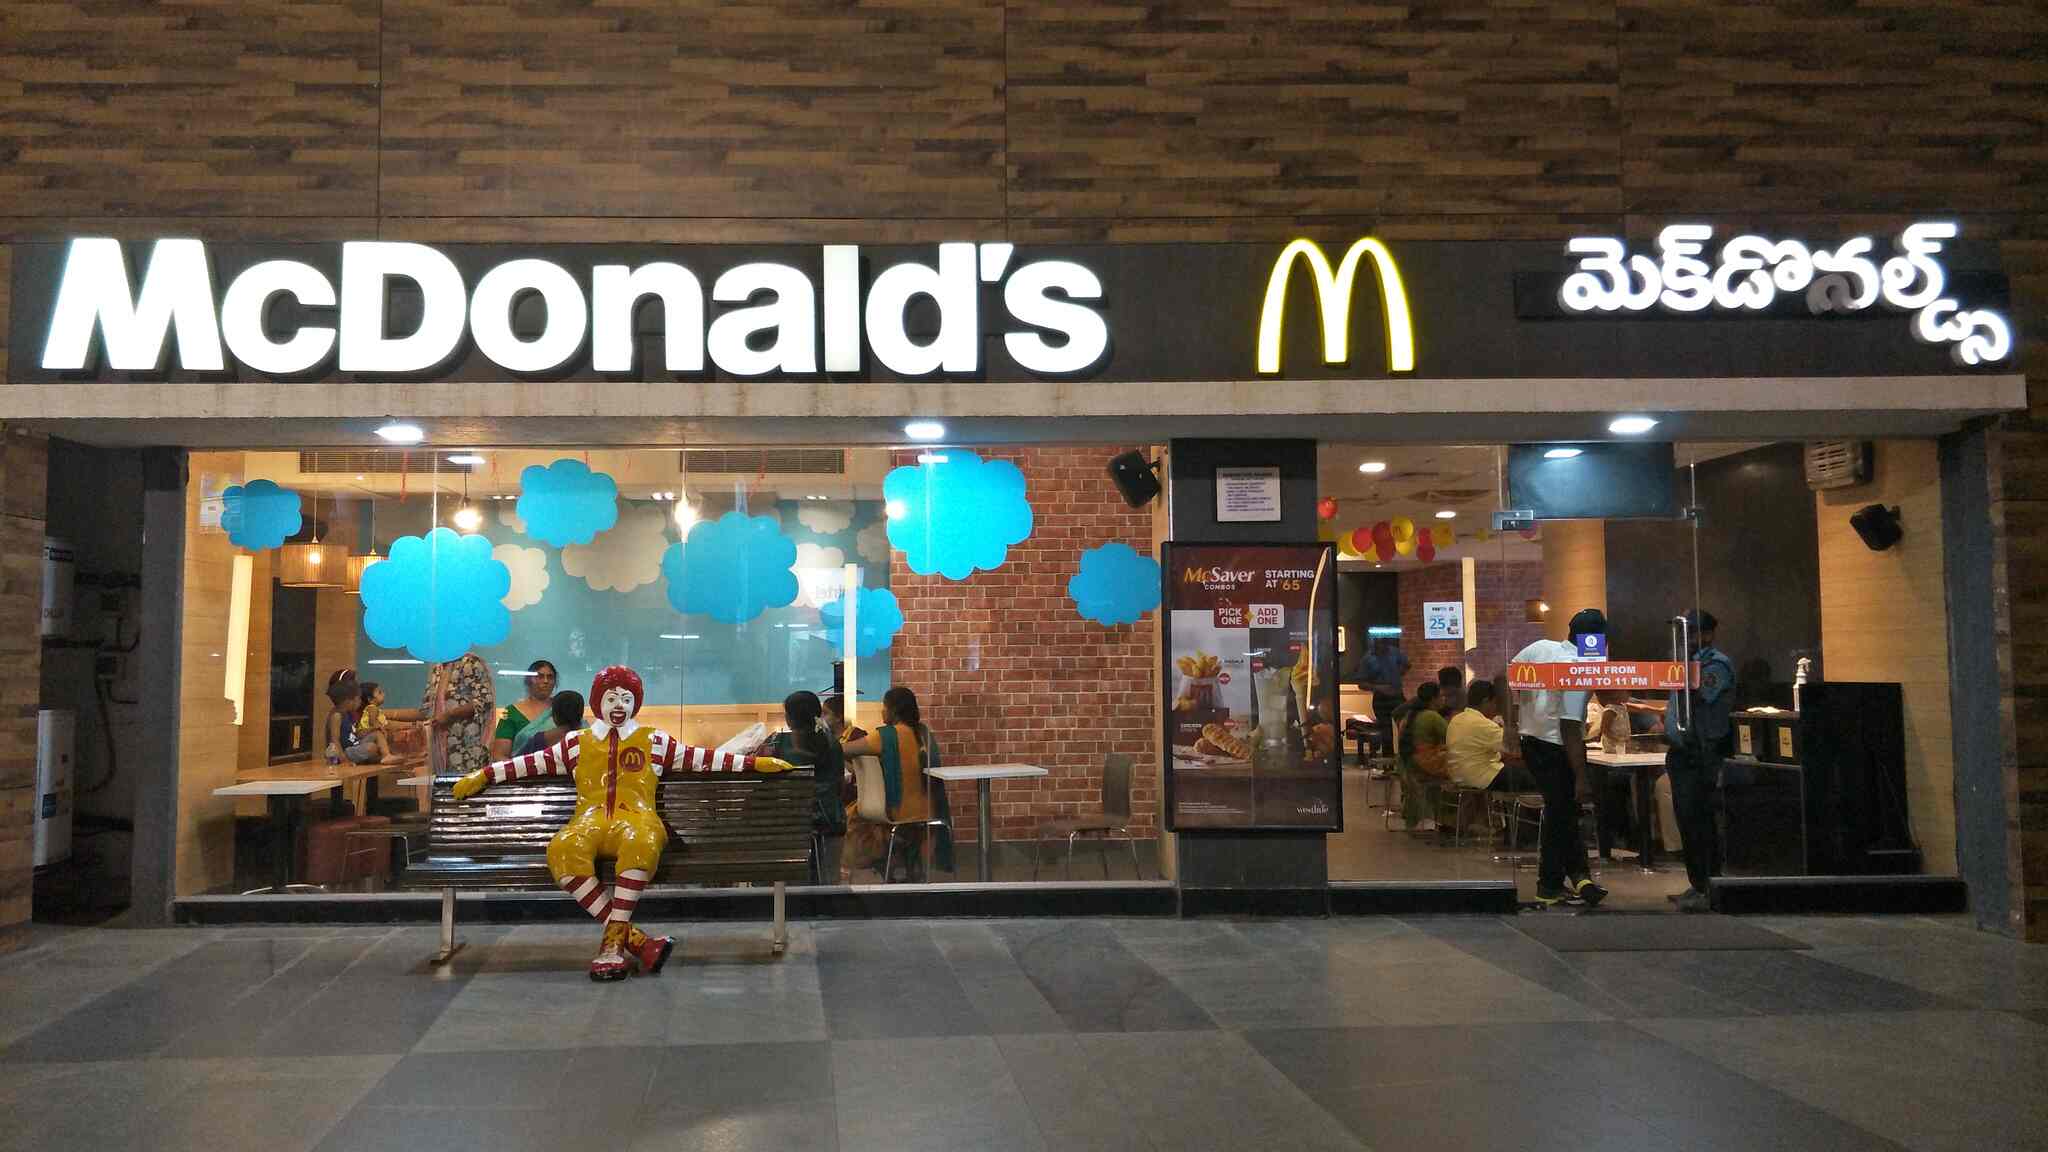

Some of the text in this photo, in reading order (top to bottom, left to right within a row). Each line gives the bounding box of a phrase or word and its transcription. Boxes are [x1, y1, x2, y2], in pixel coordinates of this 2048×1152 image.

[42, 237, 1108, 376] McDonald's
[1184, 566, 1255, 584] McSaver
[1264, 569, 1315, 578] STARTING
[1265, 579, 1277, 588] AT
[1218, 608, 1242, 617] PICK
[1257, 608, 1278, 617] ADD
[1221, 617, 1242, 626] ONE
[1257, 617, 1278, 626] ONE
[1430, 618, 1446, 630] 25
[1569, 665, 1636, 676] OPEN FROM
[1558, 676, 1648, 687] 11 AM TO 11 PM
